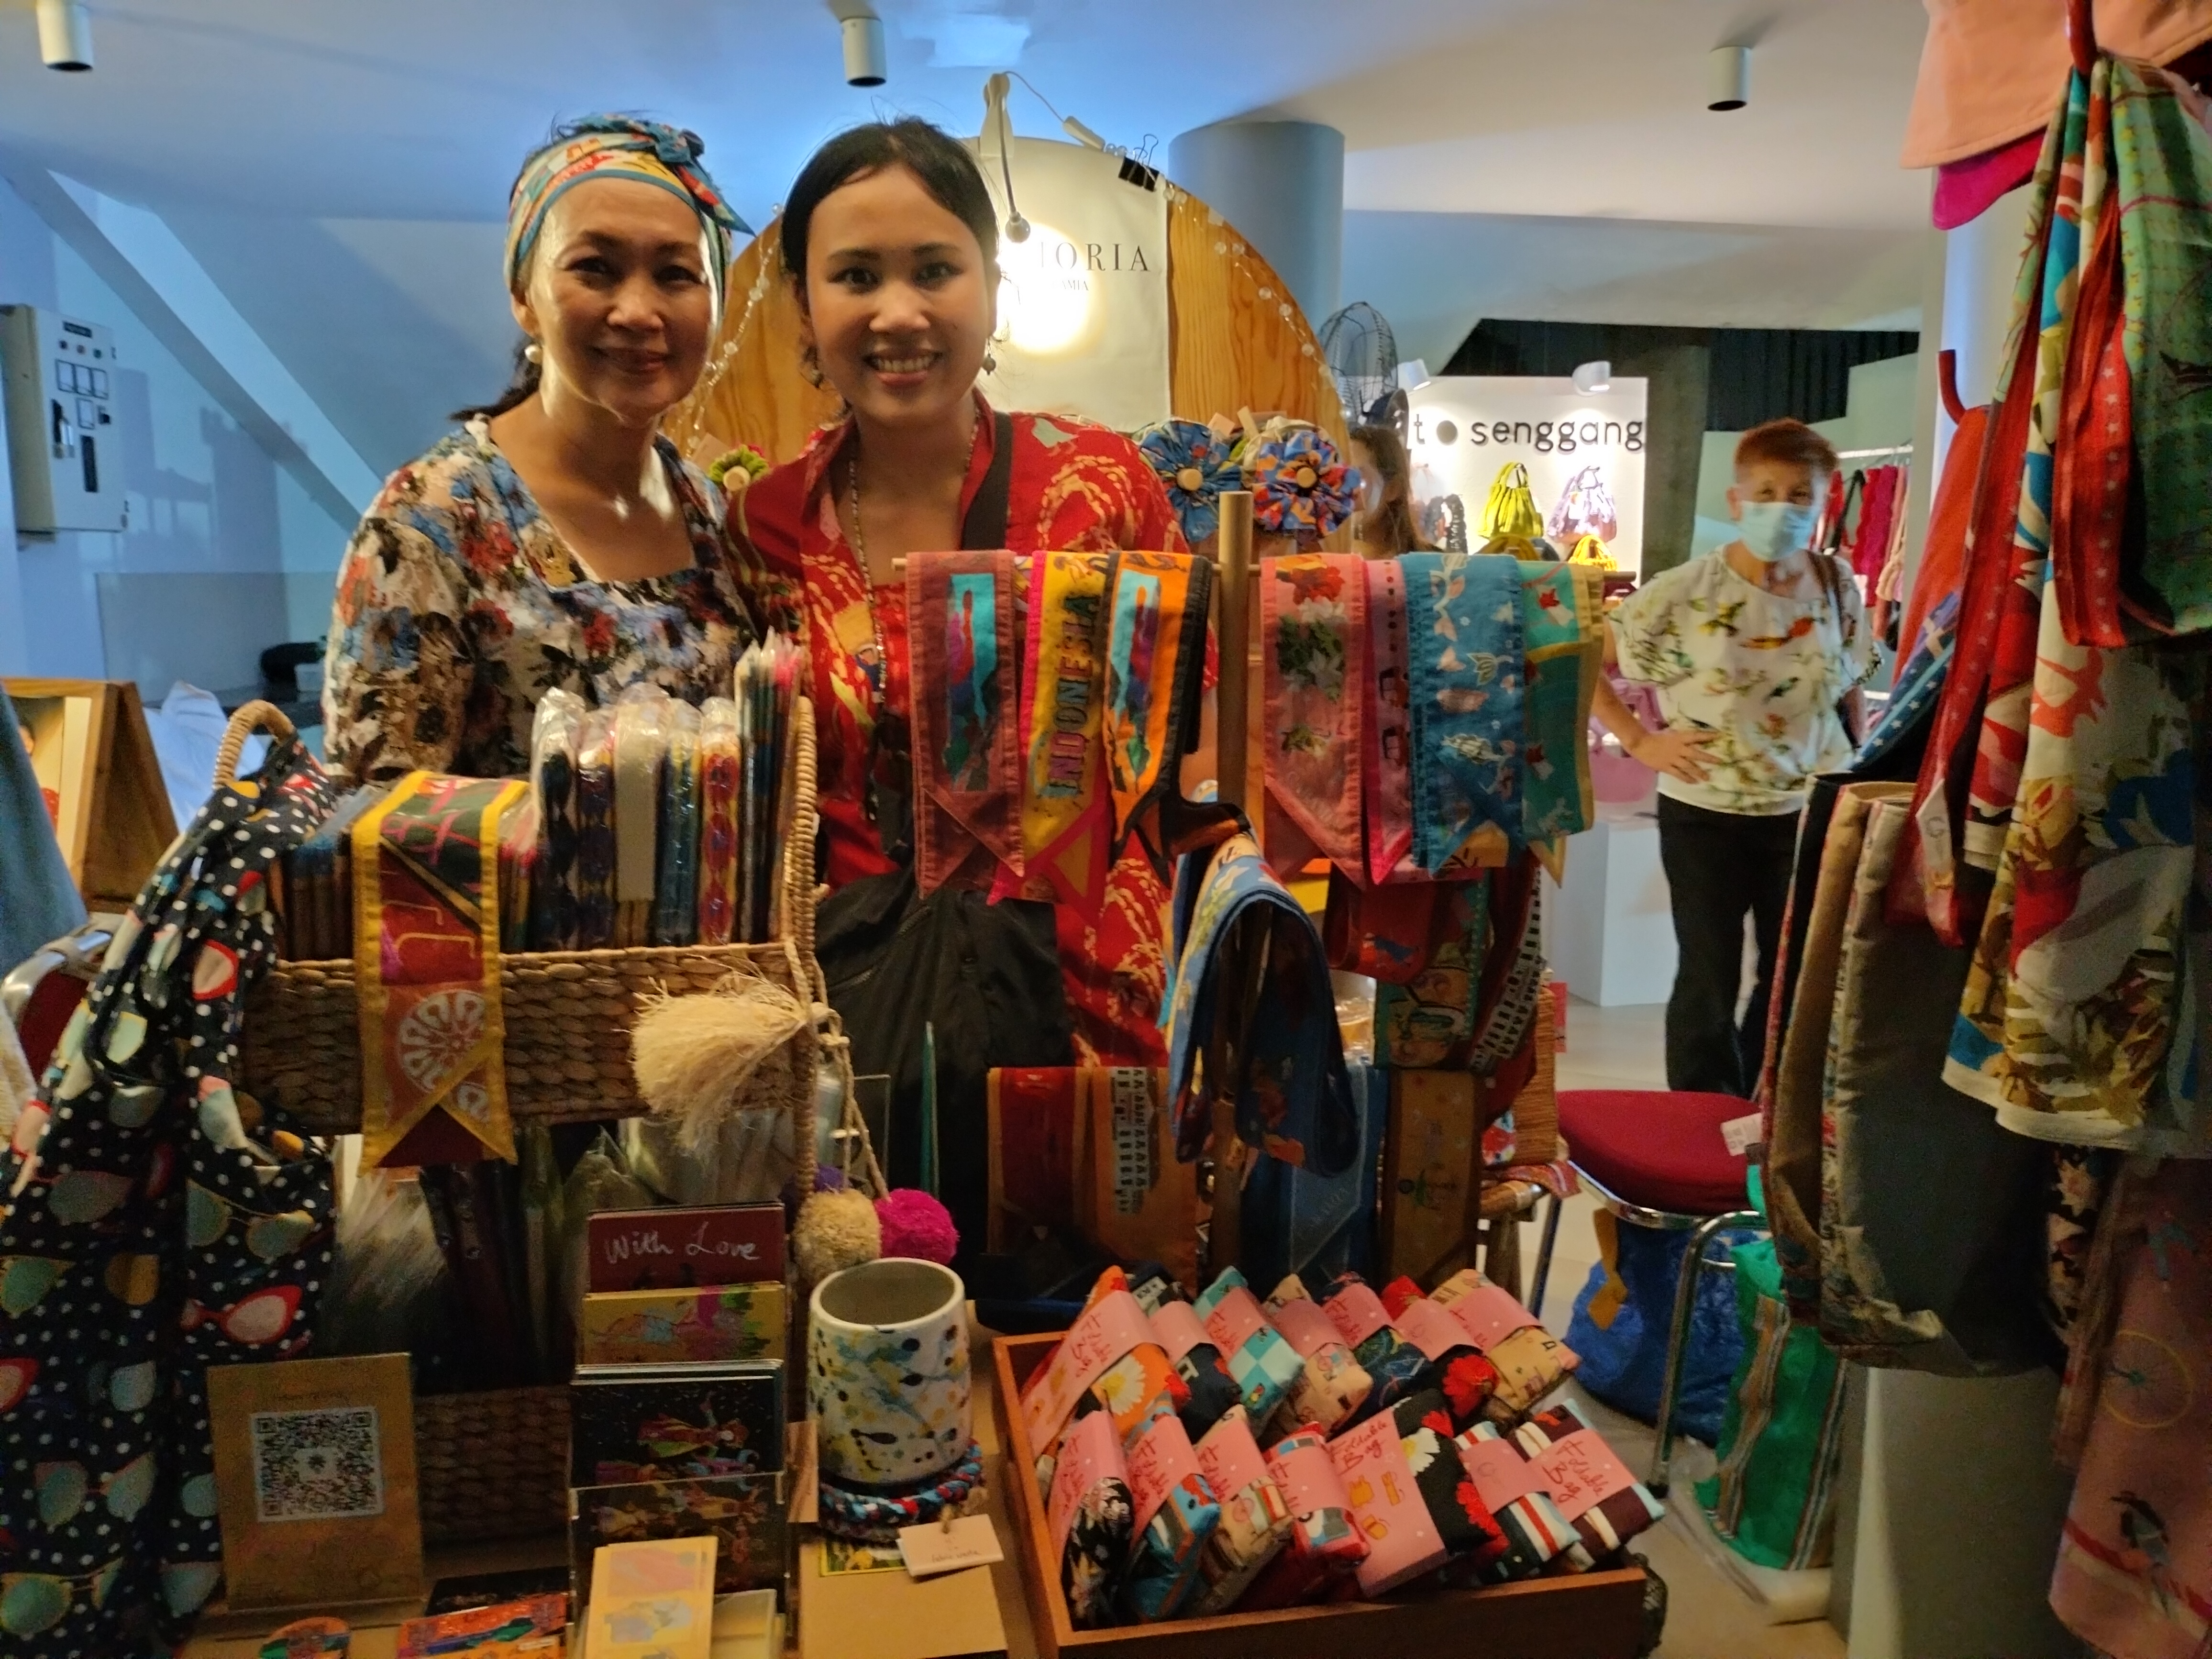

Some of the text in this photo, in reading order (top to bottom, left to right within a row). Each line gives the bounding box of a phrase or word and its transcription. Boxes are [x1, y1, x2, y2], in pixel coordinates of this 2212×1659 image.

[1471, 421, 1643, 452] senggang
[1039, 595, 1099, 797] INDONESIA
[604, 1221, 761, 1264] With Love
[1321, 1420, 1387, 1464] Foldable
[1338, 1439, 1382, 1475] Bag
[1542, 1461, 1581, 1503] Bag
[1556, 1440, 1609, 1496] Foldable
